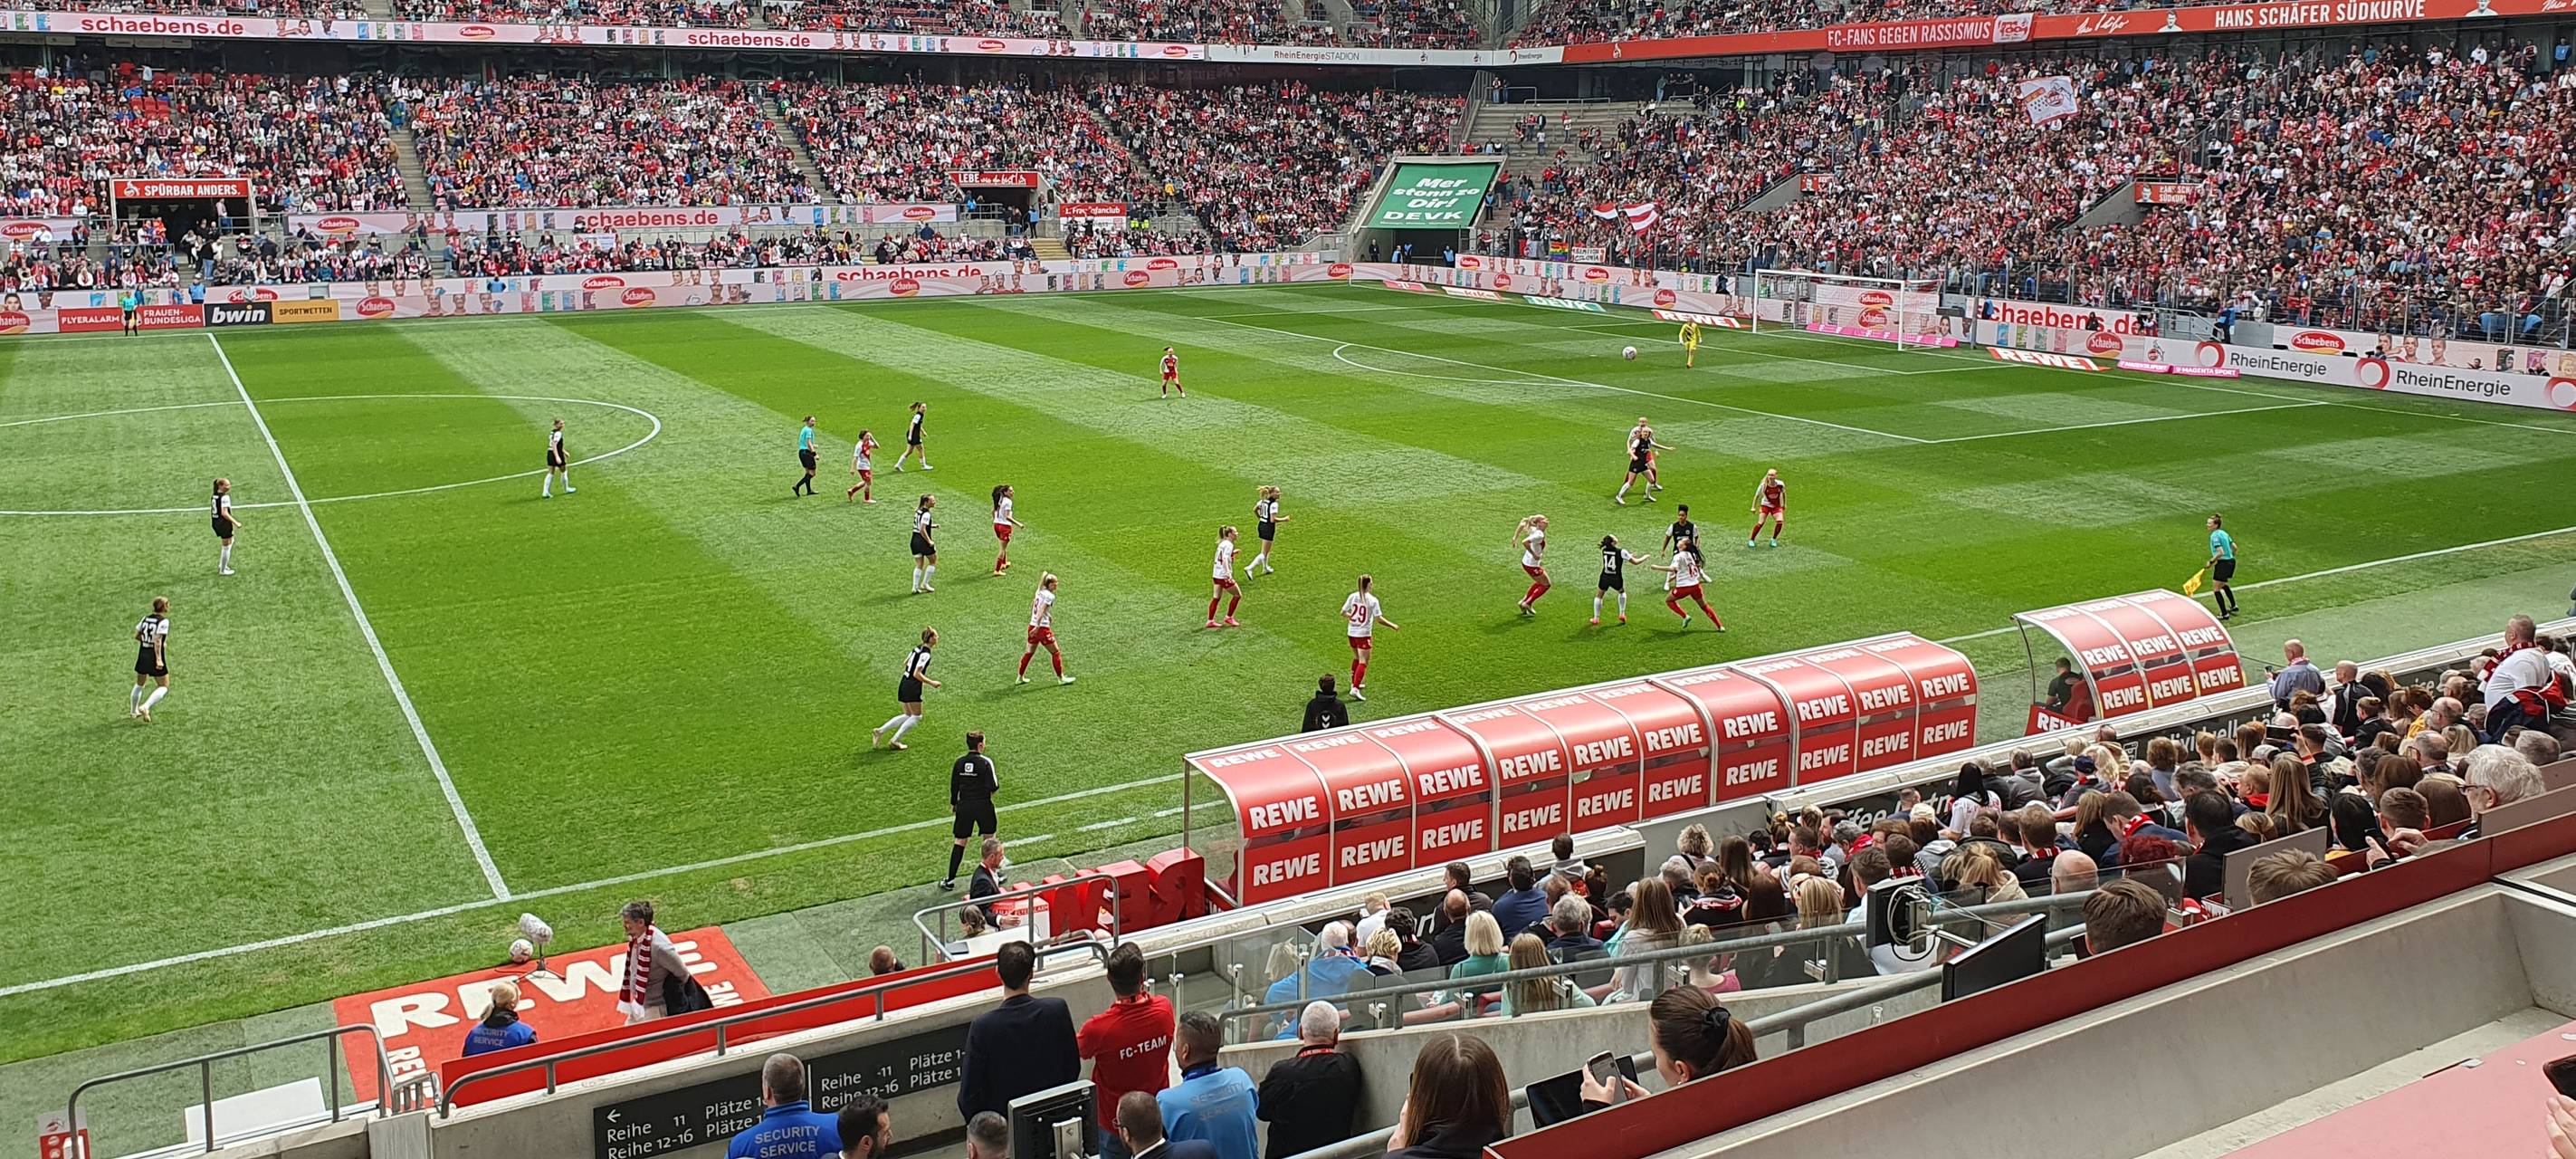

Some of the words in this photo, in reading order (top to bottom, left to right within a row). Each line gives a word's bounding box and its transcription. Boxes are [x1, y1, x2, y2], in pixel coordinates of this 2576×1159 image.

[81, 16, 243, 34] schaebens.de
[2215, 9, 2254, 28] HANS
[2258, 4, 2330, 25] SCHÄFER
[2336, 0, 2426, 22] SÜDKURVE
[688, 32, 810, 47] schaebens.de
[1827, 29, 1875, 46] FC-FANS
[1879, 26, 1917, 44] GEGEN
[1921, 22, 1991, 43] RASSISMUS
[1274, 51, 1360, 62] RheinEnergieSTADION
[145, 183, 195, 196] SPÜRBAR
[196, 184, 241, 196] ANDERS.
[959, 173, 979, 183] LEBE
[1416, 177, 1468, 189] Mer
[1392, 187, 1451, 197] stonn
[1455, 188, 1481, 196] zo
[1407, 197, 1459, 209] Dir!
[1383, 211, 1464, 220] DEVK
[61, 314, 119, 324] FLYERALARM
[143, 309, 184, 317] FRAUEN-
[143, 315, 201, 325] BUNDESLIGA
[212, 305, 266, 324] bwin
[279, 306, 332, 316] SPORTWETTEN
[2295, 335, 2341, 349] Schaebens
[2230, 352, 2327, 377] RheinEnergie
[2397, 369, 2511, 396] RheinEnergie
[1603, 554, 1617, 572] 14
[1350, 603, 1368, 624] 29
[2130, 634, 2177, 657] REWE
[2178, 625, 2225, 647] REWE
[2081, 644, 2129, 666] REWE
[1920, 672, 1970, 699] REWE
[2151, 675, 2193, 701] REWE
[2199, 665, 2240, 690] REWE
[1524, 694, 1589, 713] REWE
[1598, 682, 1657, 700] REWE
[1858, 684, 1912, 711] REWE
[2101, 685, 2144, 711] REWE
[1797, 694, 1851, 722] REWE
[1371, 719, 1442, 739] REWE
[1644, 723, 1703, 752] REWE
[1723, 711, 1779, 739] REWE
[1923, 719, 1970, 744] REWE
[1298, 732, 1365, 754] REWE
[1573, 735, 1635, 767] REWE
[1862, 731, 1910, 758] REWE
[1207, 747, 1283, 769] REWE
[1499, 749, 1562, 781] REWE
[1799, 743, 1850, 771] REWE
[1417, 763, 1484, 797] REWE
[1726, 758, 1779, 787] REWE
[1337, 778, 1406, 812] REWE
[1647, 774, 1703, 803] REWE
[1248, 795, 1321, 831] REWE
[1577, 788, 1634, 819] REWE
[1503, 803, 1562, 835] REWE
[1422, 819, 1484, 851] REWE
[1340, 834, 1406, 868] REWE
[1253, 852, 1321, 887] REWE
[1120, 1035, 1168, 1060] FC-TEAM
[821, 1072, 862, 1091] Reihe
[910, 1049, 952, 1071] Plätze
[822, 1089, 863, 1110] Reihe
[865, 1080, 899, 1097] 12-16
[910, 1067, 952, 1088] Plätze
[607, 1121, 652, 1144] Reihe
[673, 1115, 686, 1128] 11
[705, 1097, 752, 1120] Plätze
[608, 1138, 653, 1159] Reihe
[656, 1129, 693, 1150] 12-16
[706, 1116, 753, 1138] Plätze
[754, 1125, 820, 1145] SECURITY
[759, 1141, 816, 1159] SERVICE
